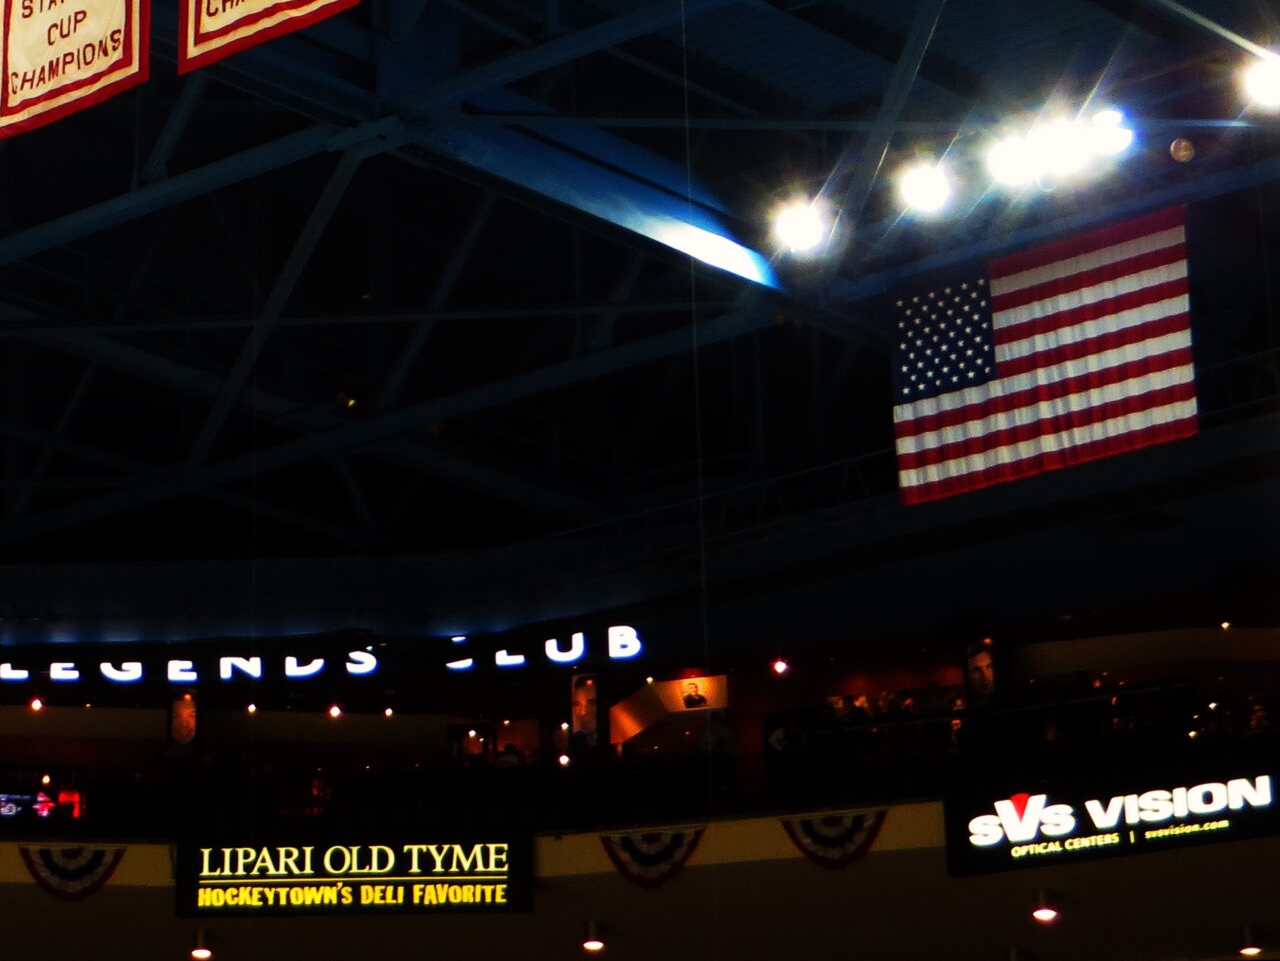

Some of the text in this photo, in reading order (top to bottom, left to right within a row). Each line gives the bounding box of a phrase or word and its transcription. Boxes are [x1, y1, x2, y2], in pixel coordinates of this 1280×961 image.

[48, 10, 87, 47] CUP
[10, 28, 122, 95] CHAMPIONS
[1085, 775, 1272, 829] VISION
[199, 843, 509, 876] LIPARI OLD TYME
[1010, 841, 1063, 858] OPTICAL
[1064, 832, 1120, 850] CENTERS
[198, 882, 507, 907] HOCKEYTOWN'S DELI FAVORITE
